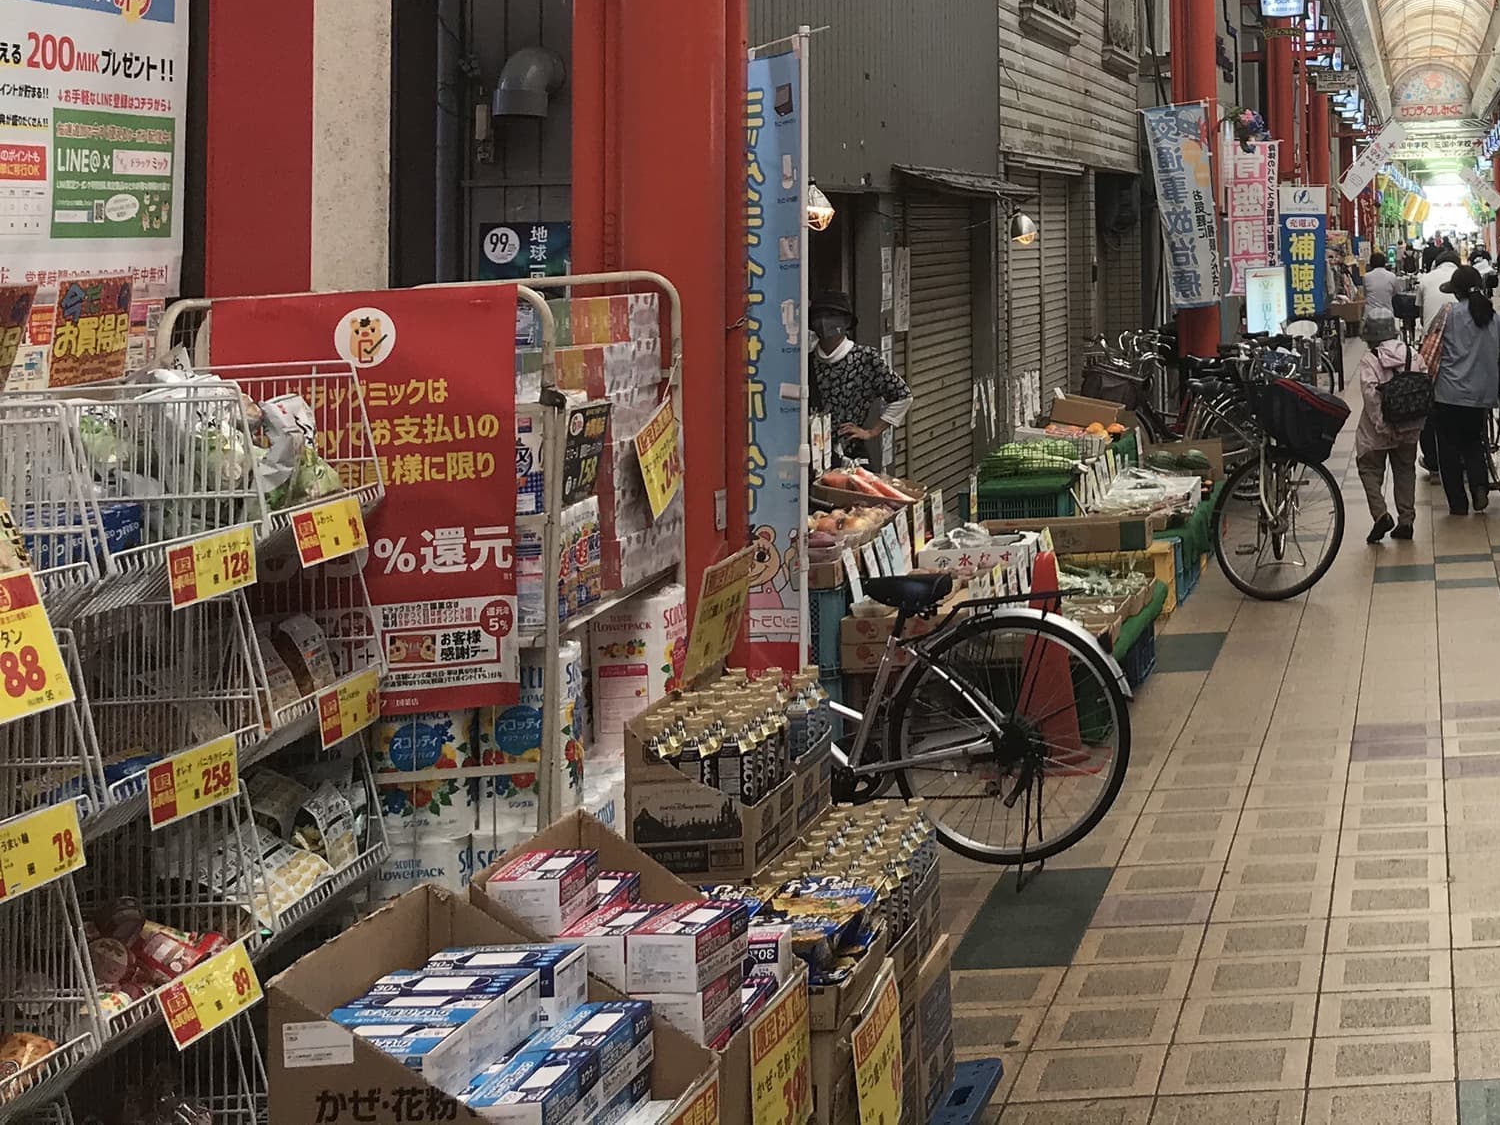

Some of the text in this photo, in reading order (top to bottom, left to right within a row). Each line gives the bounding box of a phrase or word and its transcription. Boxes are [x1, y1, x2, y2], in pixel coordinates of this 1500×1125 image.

[489, 232, 510, 253] 99
[1289, 233, 1316, 318] 補聴器
[53, 313, 129, 359] お買得品
[222, 551, 250, 581] 128
[440, 629, 482, 647] お客様
[489, 618, 509, 631] 5%
[440, 645, 489, 662] 感謝デー
[498, 716, 542, 732] スコッティ
[392, 735, 439, 752] スコッティ
[202, 760, 232, 796] 258
[743, 755, 753, 797] UCC
[52, 828, 75, 863] 78
[232, 966, 251, 996] 89
